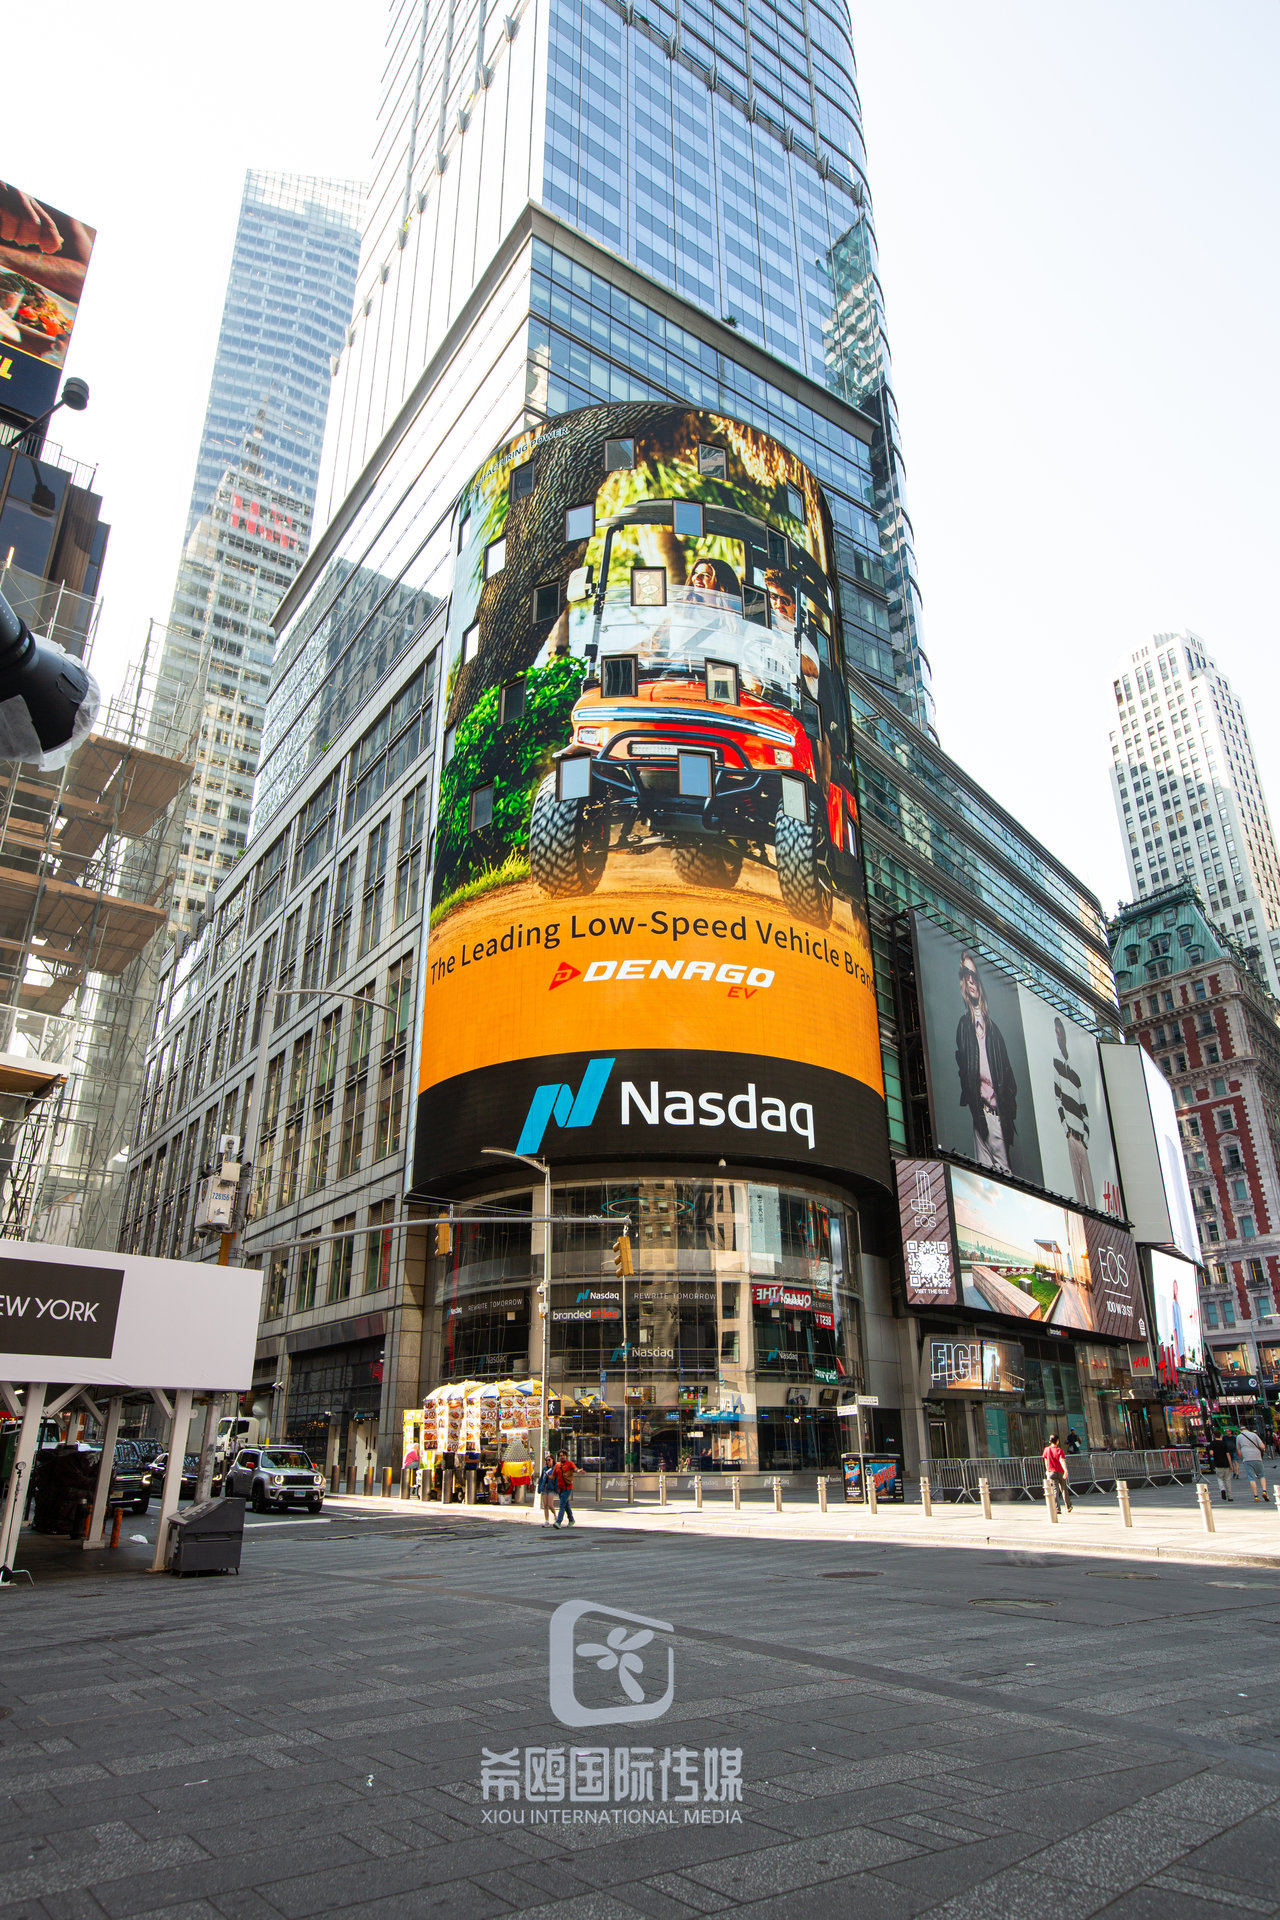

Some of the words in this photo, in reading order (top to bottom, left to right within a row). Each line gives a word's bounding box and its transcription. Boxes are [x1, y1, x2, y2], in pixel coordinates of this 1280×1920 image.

[431, 955, 455, 985] The
[461, 923, 560, 967] Leading
[571, 910, 747, 941] Low-Speed
[756, 920, 840, 967] Vehicle
[583, 960, 775, 988] DENAGO
[728, 987, 757, 999] EV
[621, 1081, 816, 1150] Nasdaq
[490, 1299, 523, 1309] TOMORROW
[590, 1291, 620, 1301] Nasdaq
[634, 1292, 668, 1300] REWRITE
[672, 1292, 716, 1300] TOMORROW
[35, 1297, 100, 1322] YORK
[632, 1347, 674, 1359] Nasdaq
